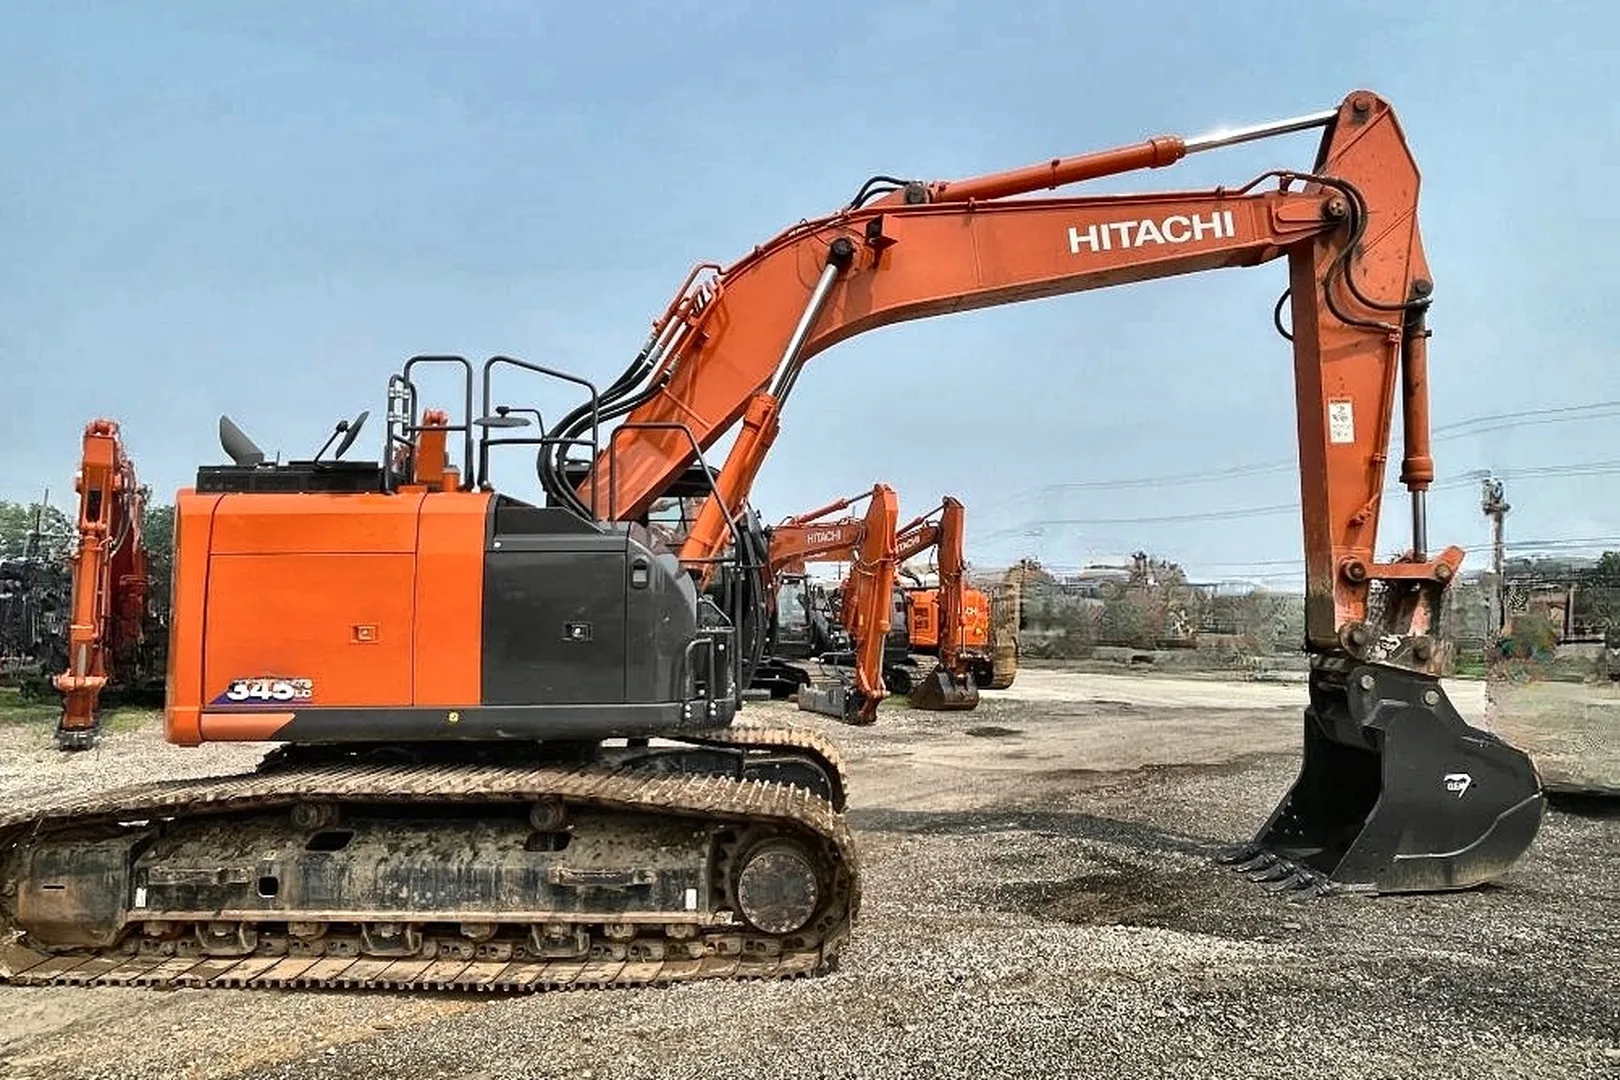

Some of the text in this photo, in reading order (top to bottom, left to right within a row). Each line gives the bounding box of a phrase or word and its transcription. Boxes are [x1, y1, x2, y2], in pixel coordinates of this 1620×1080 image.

[1068, 210, 1236, 254] HITACHI
[807, 529, 842, 545] HITACHI
[226, 679, 295, 701] 345
